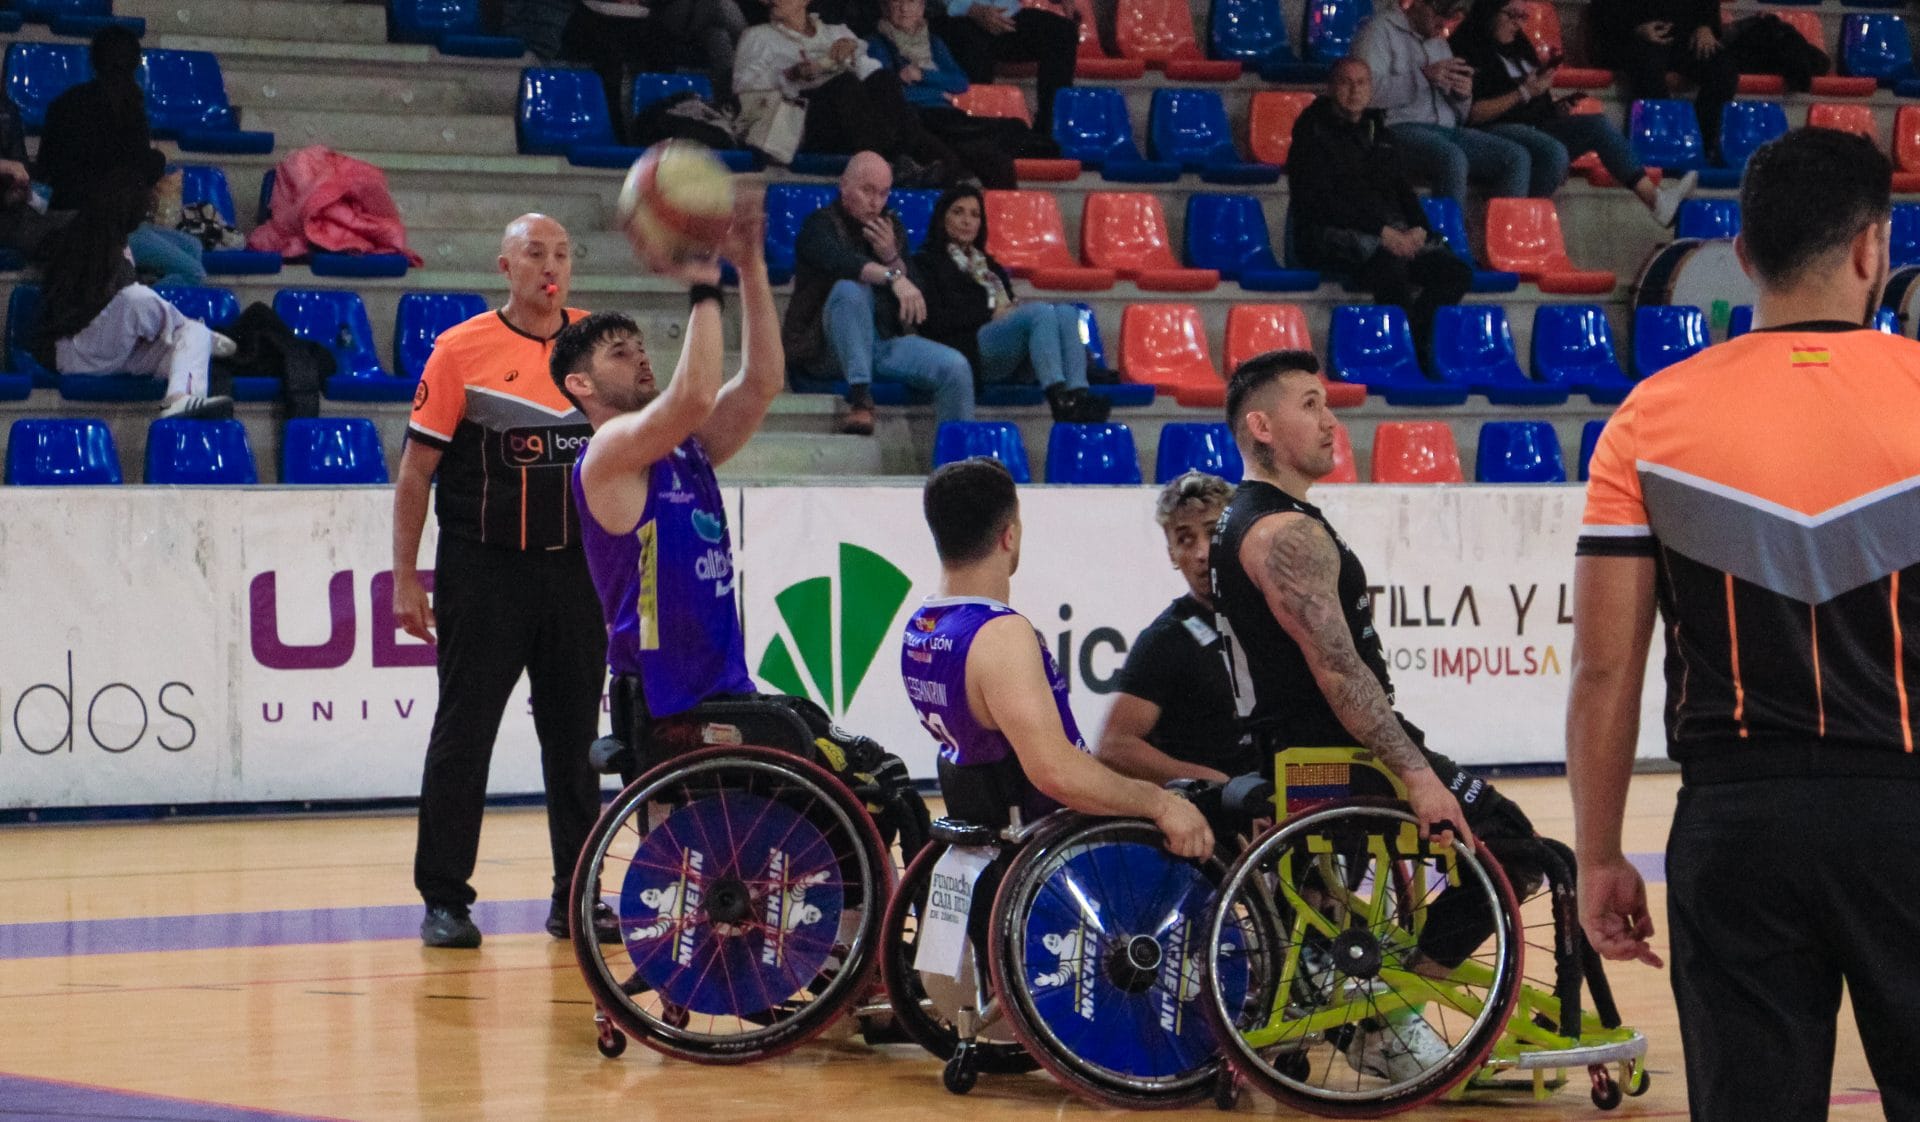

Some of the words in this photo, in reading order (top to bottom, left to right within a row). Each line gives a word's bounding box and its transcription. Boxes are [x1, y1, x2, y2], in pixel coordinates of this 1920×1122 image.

[1509, 582, 1538, 636] Y
[929, 633, 953, 651] LEÓN
[1432, 645, 1561, 684] IMPULSA
